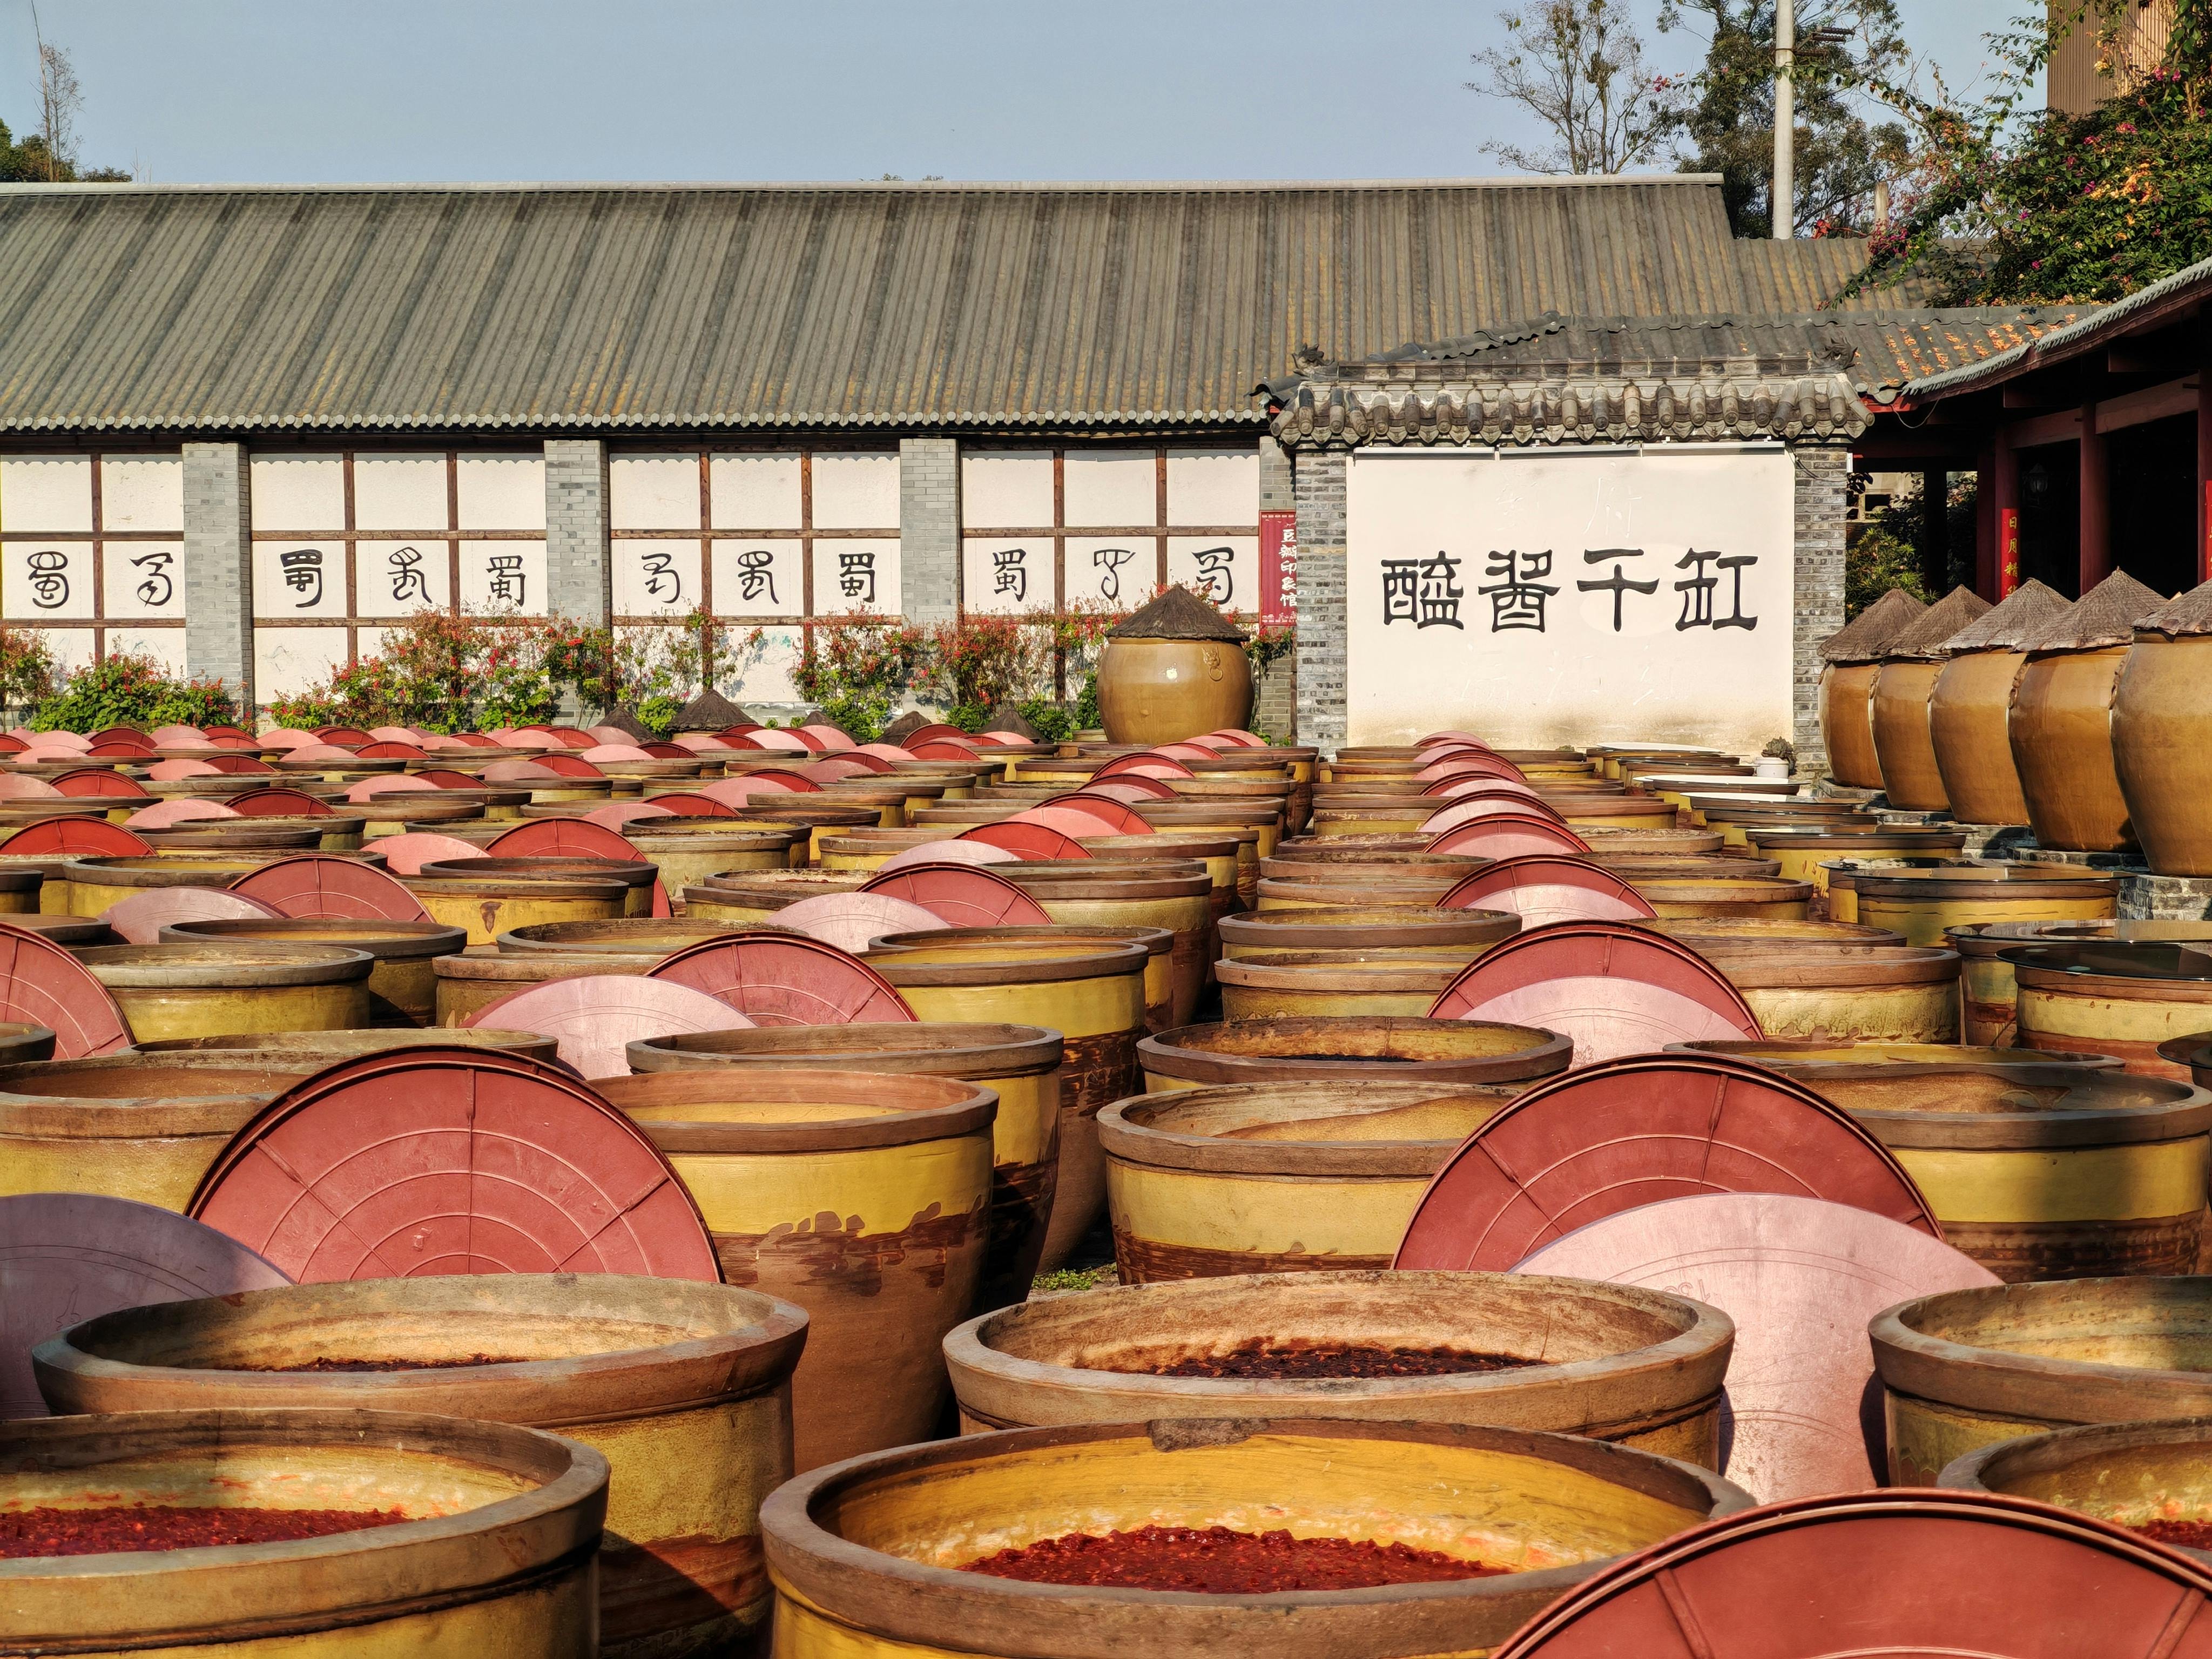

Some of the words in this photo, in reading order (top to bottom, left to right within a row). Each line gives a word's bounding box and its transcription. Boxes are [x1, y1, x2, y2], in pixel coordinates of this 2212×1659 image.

[28, 551, 69, 608] 蜀
[280, 550, 322, 608] 蜀
[487, 556, 525, 606] 蜀
[839, 553, 875, 603] 蜀
[993, 549, 1026, 601] 蜀
[1278, 529, 1297, 607] 豆瓣印象馆
